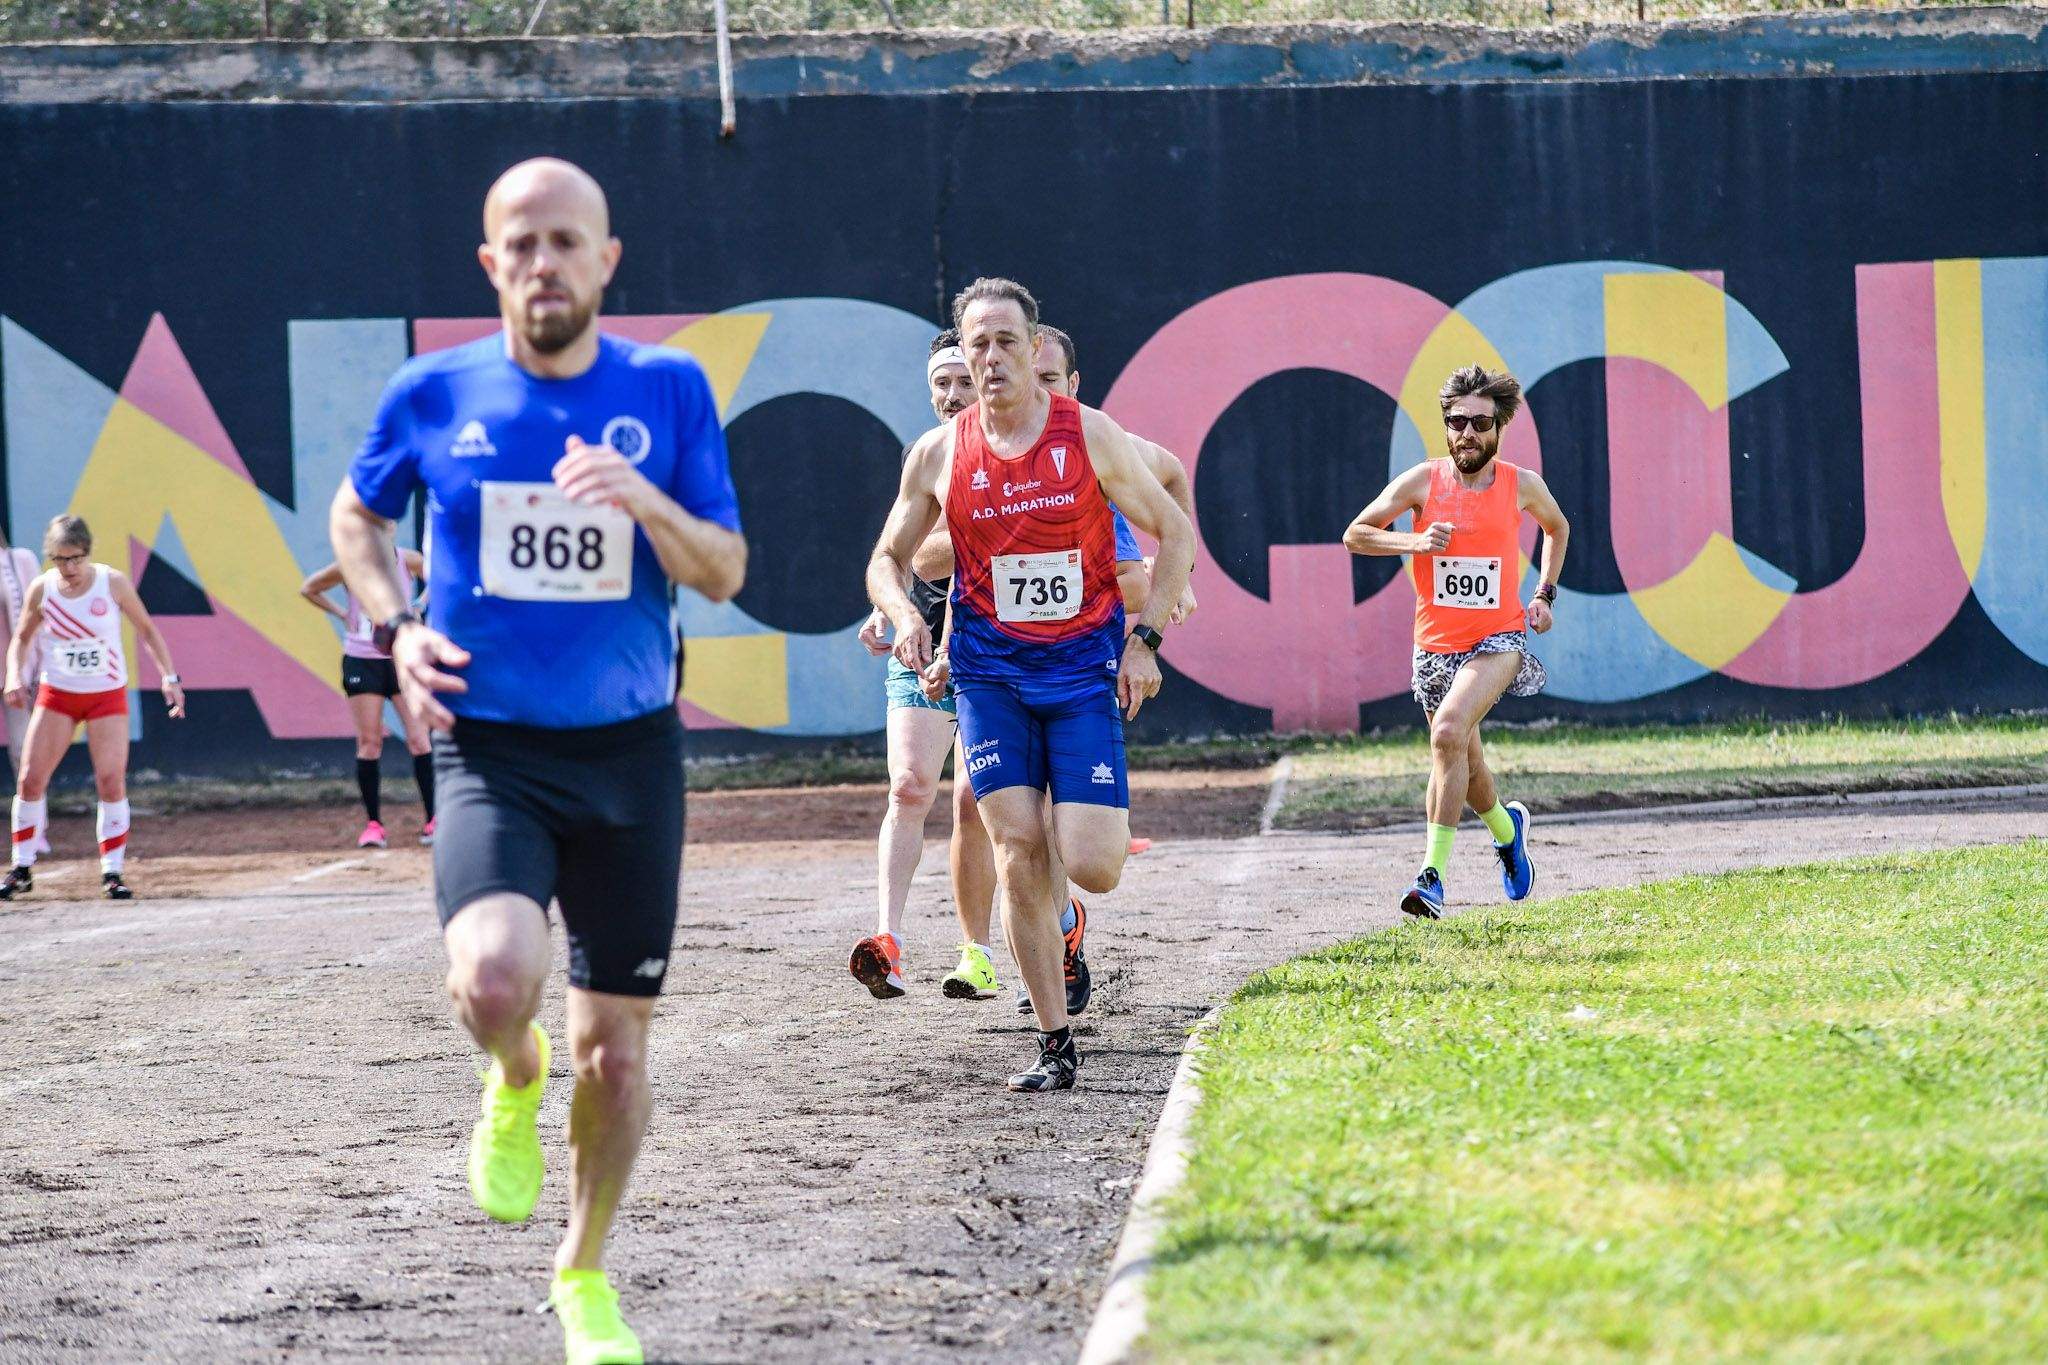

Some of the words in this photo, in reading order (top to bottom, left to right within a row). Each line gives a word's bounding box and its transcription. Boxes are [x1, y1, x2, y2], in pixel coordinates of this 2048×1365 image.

[972, 507, 998, 520] A.D.
[1001, 493, 1075, 516] MARATHON
[510, 524, 604, 571] 868
[1009, 575, 1068, 606] 736
[1445, 574, 1488, 596] 690
[66, 650, 100, 668] 765
[969, 752, 1001, 775] ADM
